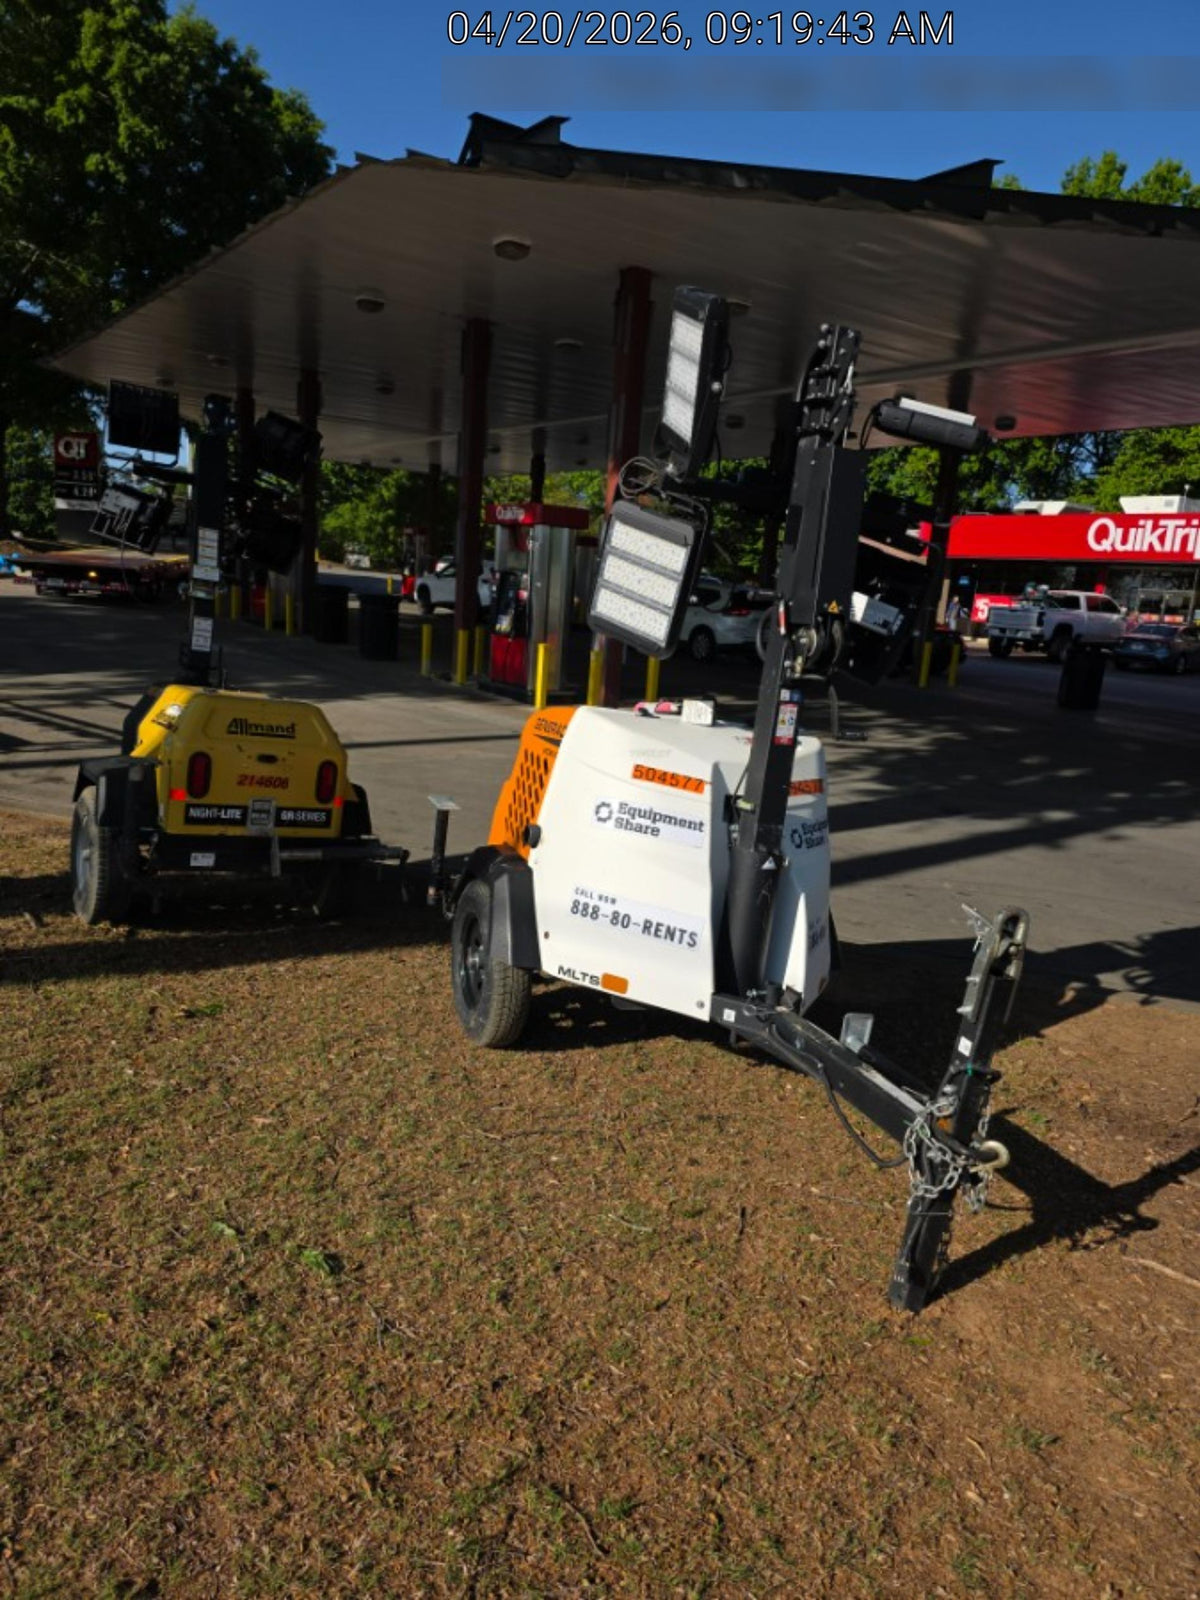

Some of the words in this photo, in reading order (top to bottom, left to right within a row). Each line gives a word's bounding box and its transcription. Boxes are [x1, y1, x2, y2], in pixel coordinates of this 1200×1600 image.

[226, 717, 296, 738] Allmand
[633, 763, 705, 792] 504577
[614, 815, 661, 837] Share
[617, 802, 705, 833] Equipment
[570, 898, 698, 948] 888-80-RENTS
